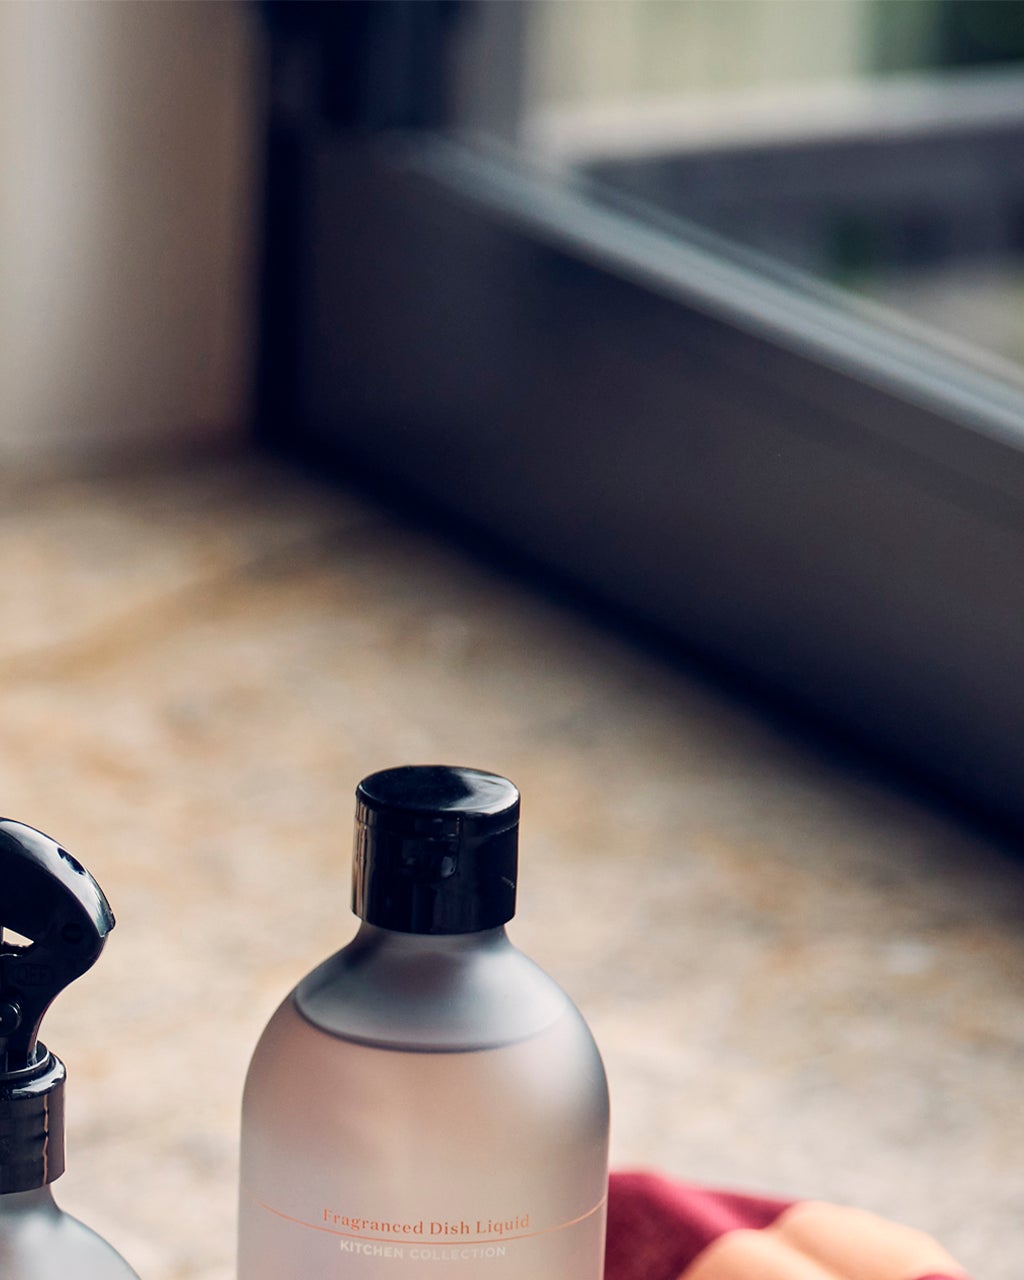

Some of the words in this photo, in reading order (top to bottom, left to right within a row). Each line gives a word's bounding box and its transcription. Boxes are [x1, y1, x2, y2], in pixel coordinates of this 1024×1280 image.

[322, 1208, 424, 1236] Fragranced
[429, 1220, 471, 1236] Dish
[476, 1213, 530, 1236] Liquid
[340, 1240, 404, 1260] KITCHEN
[410, 1245, 507, 1261] COLLECTION
